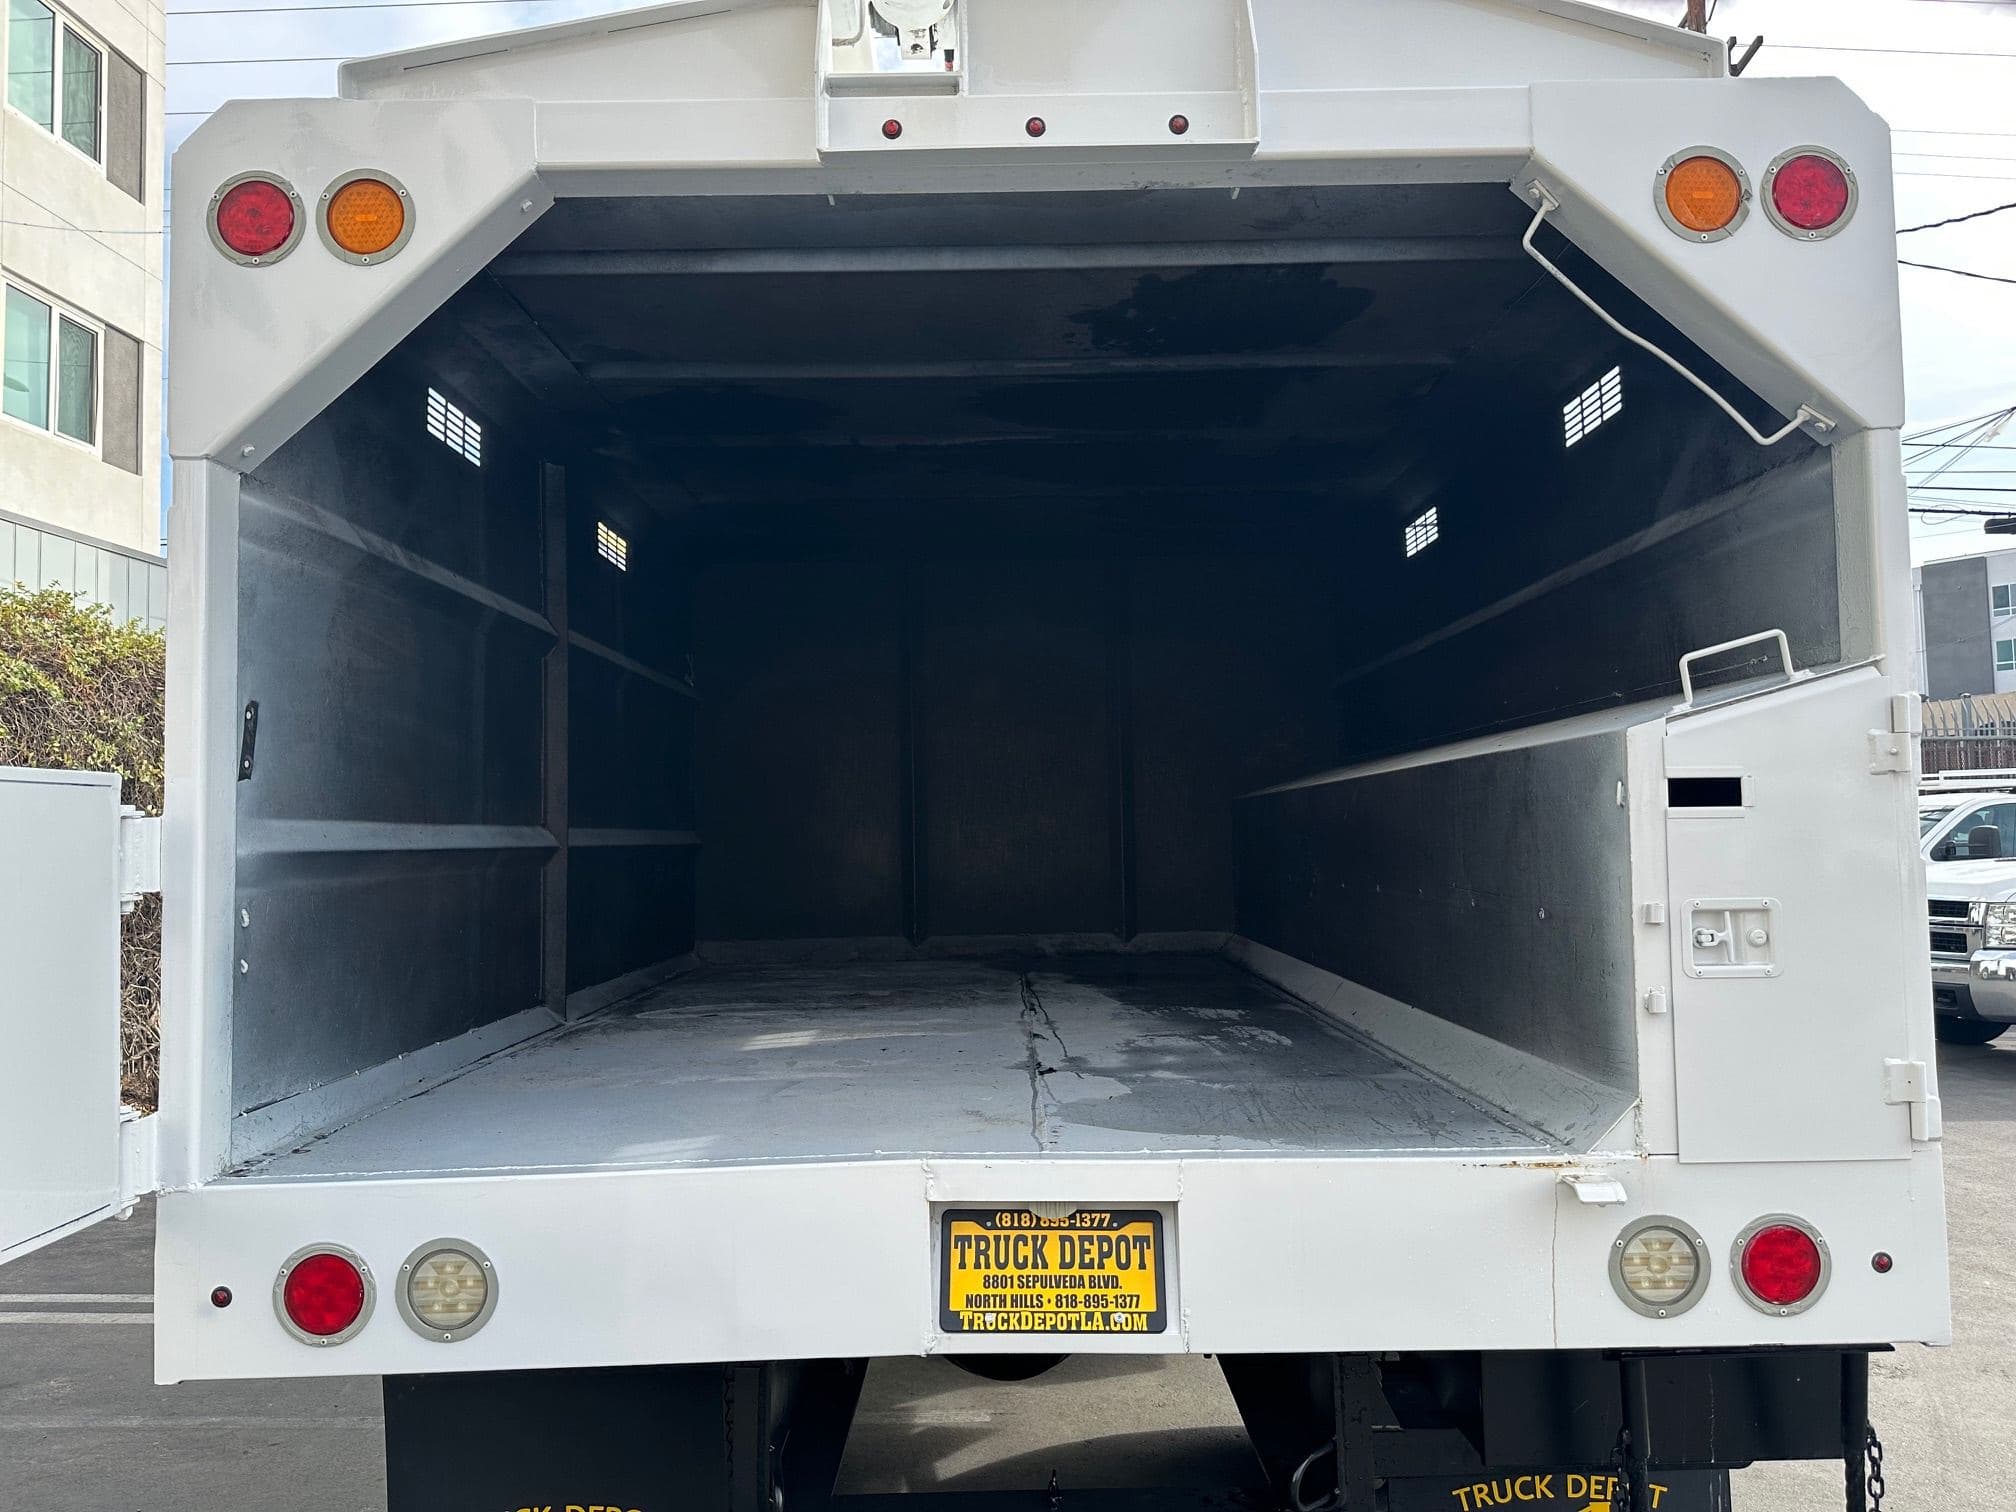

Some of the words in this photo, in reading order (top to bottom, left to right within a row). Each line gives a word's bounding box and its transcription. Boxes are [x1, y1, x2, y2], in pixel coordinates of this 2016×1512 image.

[995, 1212, 1035, 1228] (818)
[954, 1234, 1049, 1270] TRUCK
[1058, 1234, 1151, 1270] DEPOT
[983, 1274, 1014, 1289] 8801
[1017, 1274, 1086, 1289] SEPULVEDA
[1088, 1274, 1123, 1289] BLVD.
[965, 1294, 1006, 1309] NORTH
[1012, 1294, 1044, 1309] HILLS
[1055, 1294, 1140, 1309] 818-895-1377
[1451, 1474, 1555, 1512] TRUCK
[1566, 1474, 1668, 1509] DEPT
